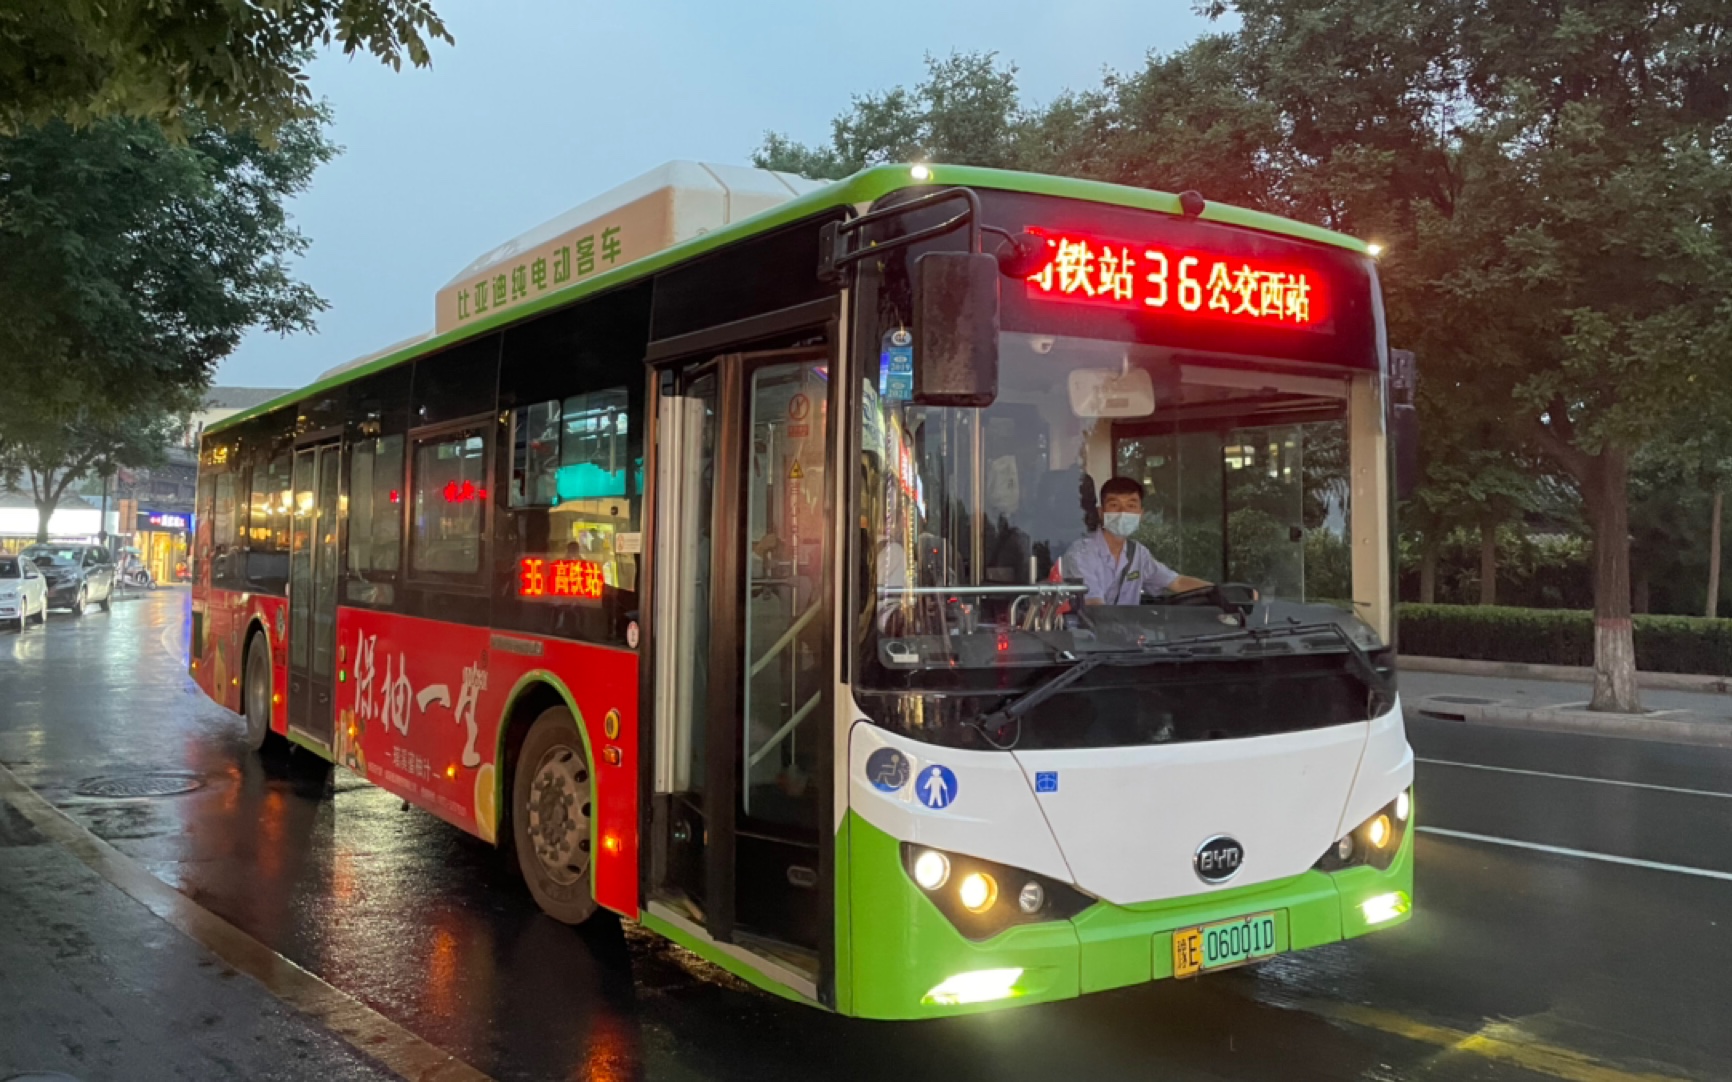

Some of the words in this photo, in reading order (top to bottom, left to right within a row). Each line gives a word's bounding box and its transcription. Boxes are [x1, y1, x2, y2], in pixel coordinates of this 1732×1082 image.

[458, 226, 622, 320] 比亚迪纯电动客车
[1144, 250, 1202, 312] 36
[1207, 261, 1311, 322] 公交西站
[555, 559, 602, 597] 高铁站
[1201, 847, 1239, 871] BYD
